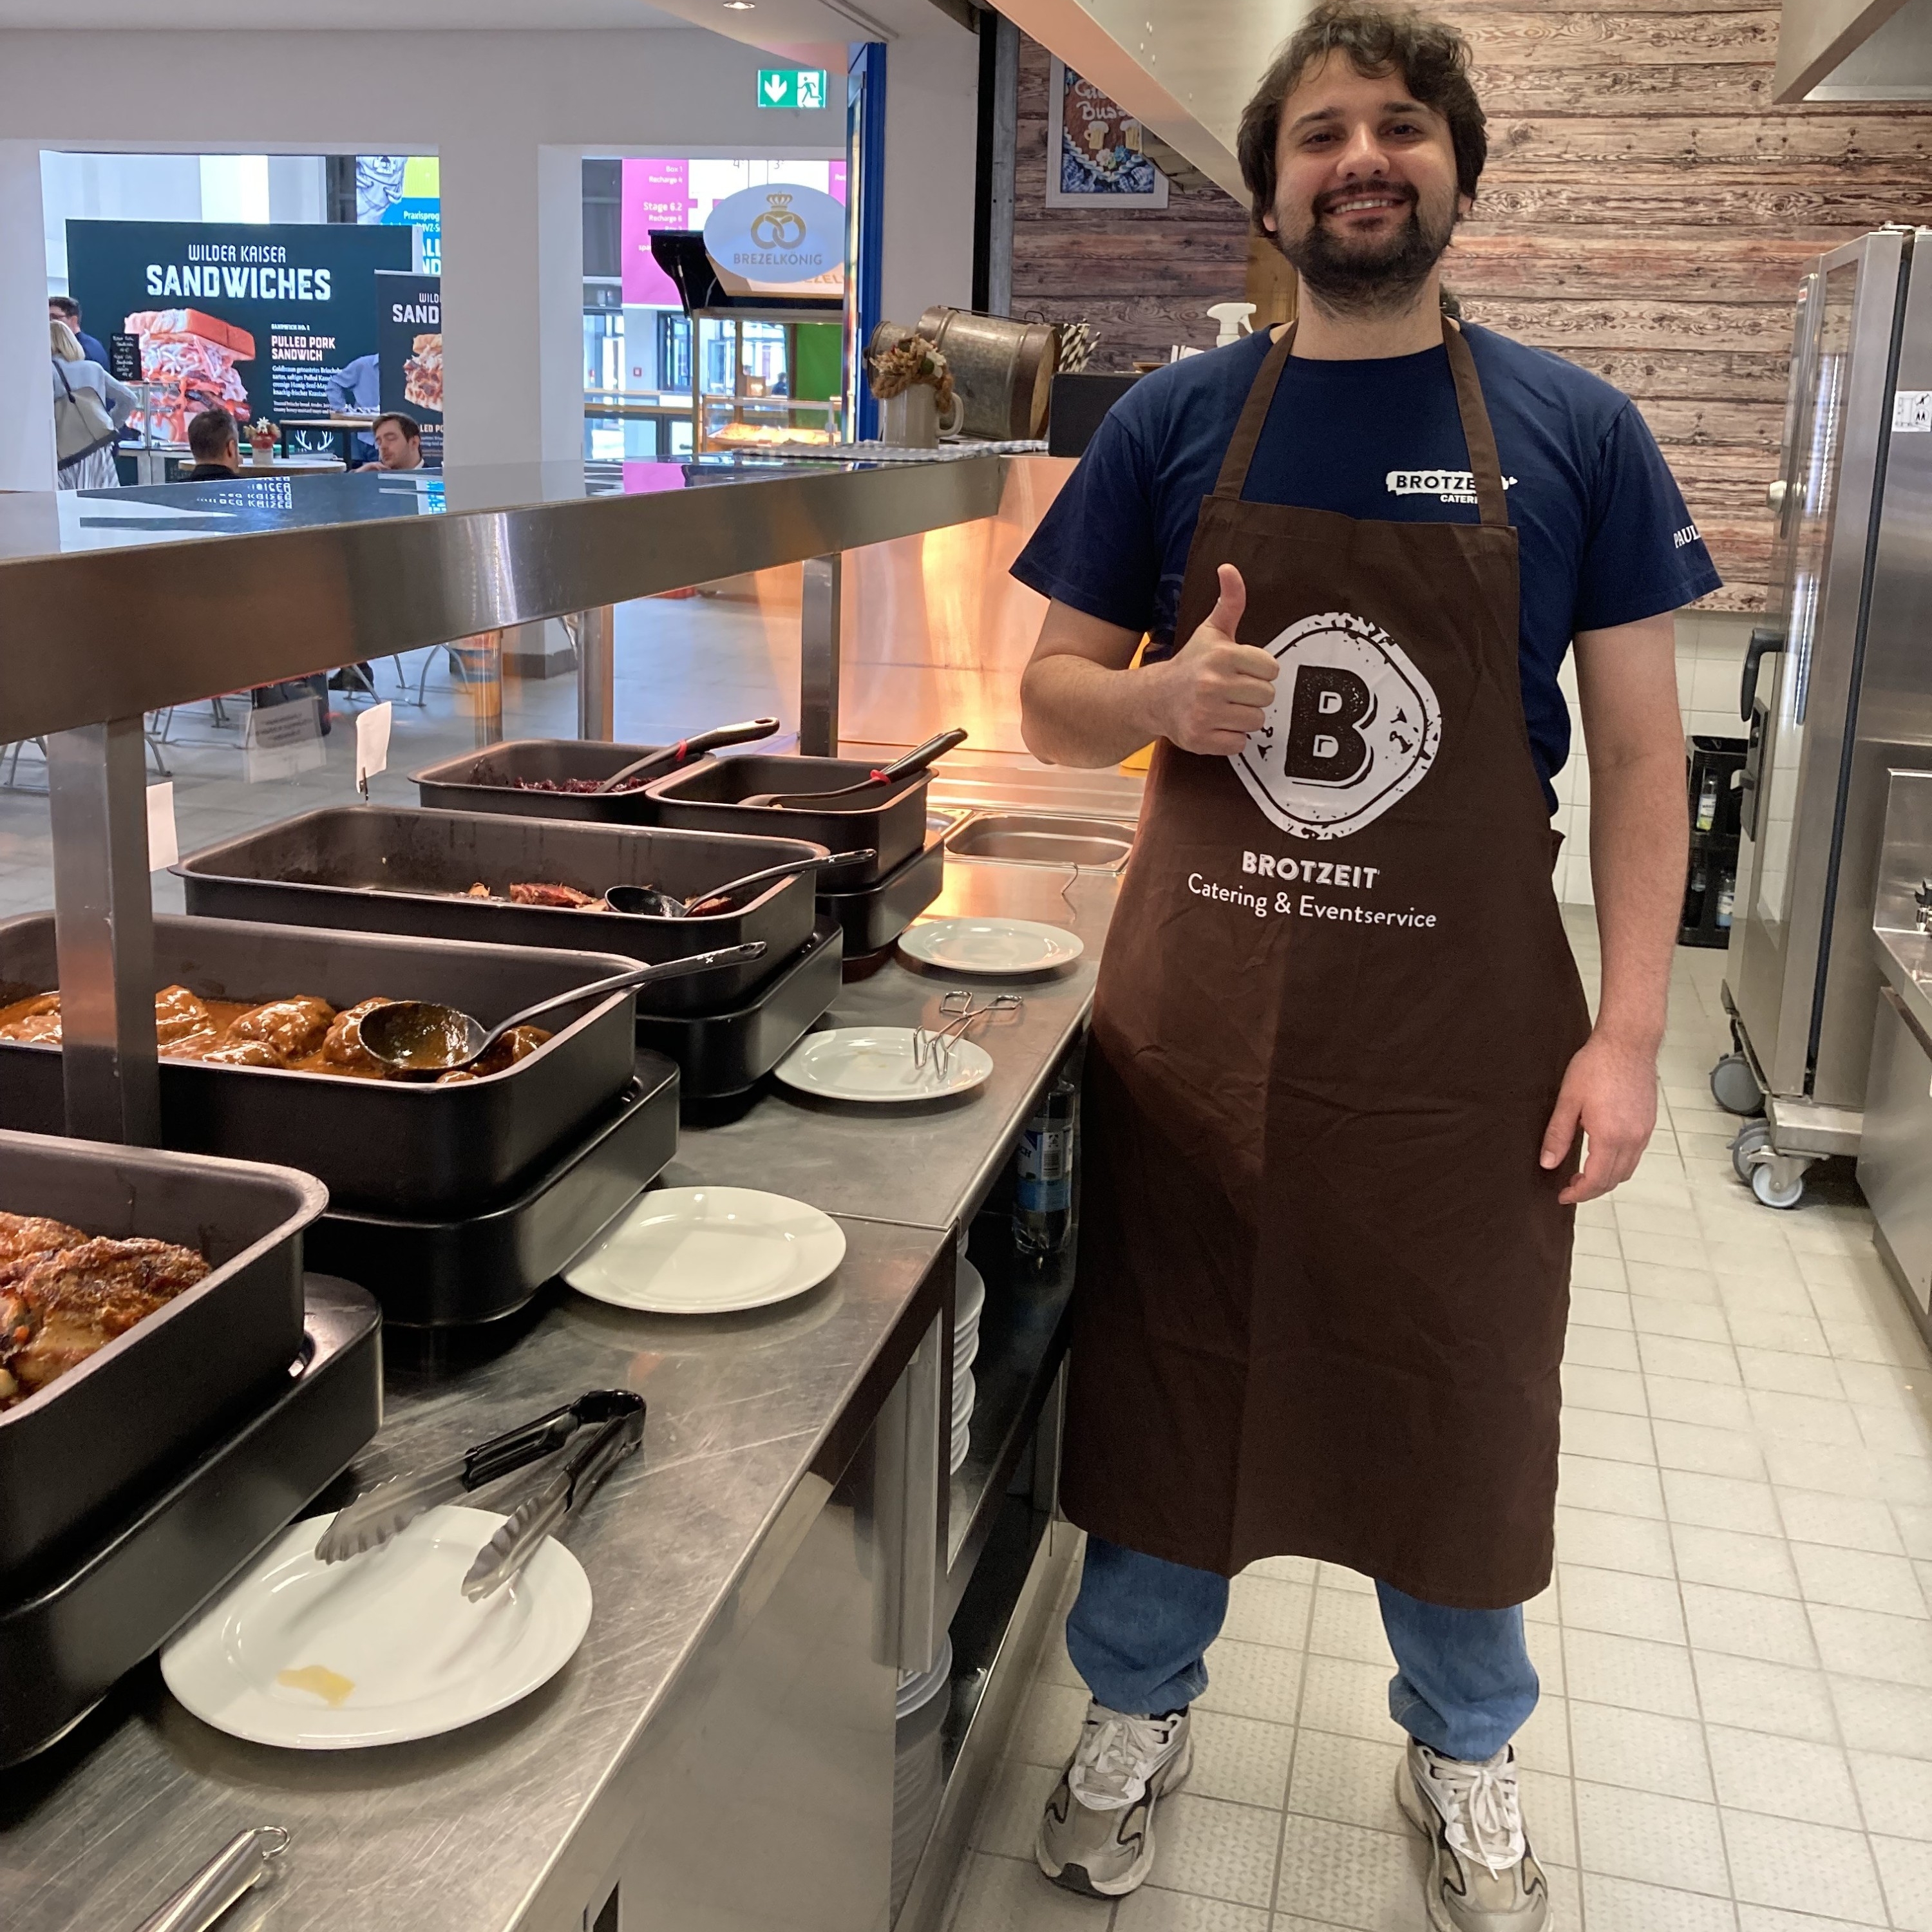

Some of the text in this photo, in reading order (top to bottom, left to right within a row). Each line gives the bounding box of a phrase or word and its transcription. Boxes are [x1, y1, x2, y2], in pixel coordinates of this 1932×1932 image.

[1076, 100, 1132, 120] Buss
[649, 176, 677, 185] Recharge
[643, 202, 683, 213] Stage 6.2
[404, 211, 440, 222] Praxisprog
[649, 214, 677, 223] Recharge
[189, 244, 287, 263] WILDER KAISER
[734, 251, 822, 265] BREZELKÖNIG
[146, 265, 330, 300] SANDWICHES
[419, 293, 439, 303] WILD
[392, 304, 439, 324] SAND
[272, 336, 336, 349] PULLED PORK
[272, 348, 323, 361] SANDWICH
[1396, 475, 1476, 489] BROTZE
[1440, 494, 1479, 504] CATERI
[1673, 525, 1701, 549] PAUL
[1284, 664, 1378, 790] B
[1242, 850, 1379, 889] BROTZEIT
[1188, 873, 1437, 928] Catering & Eventservice
